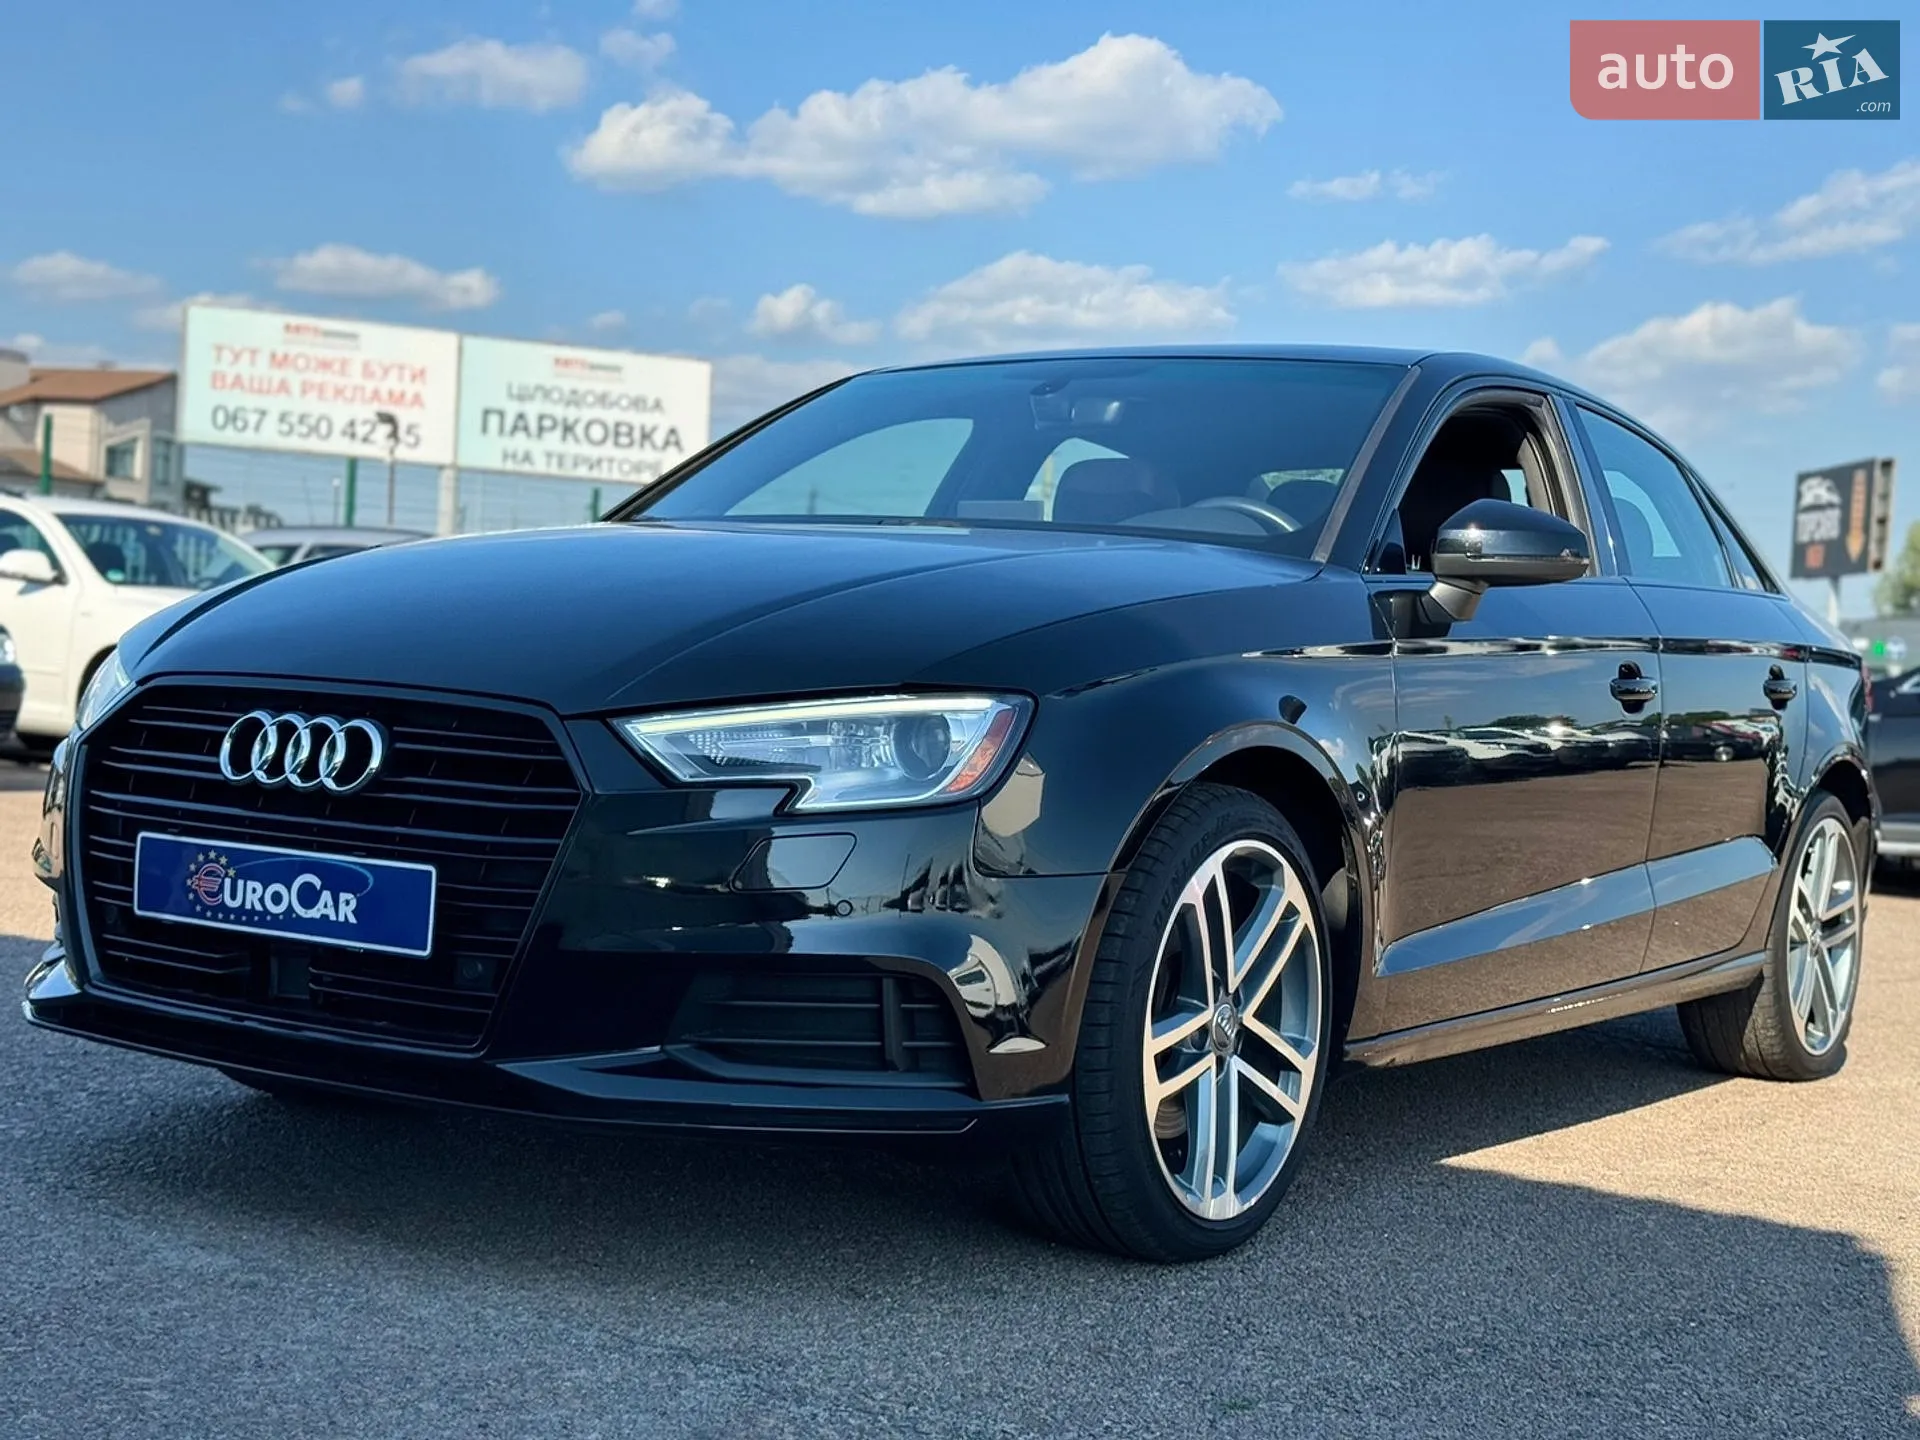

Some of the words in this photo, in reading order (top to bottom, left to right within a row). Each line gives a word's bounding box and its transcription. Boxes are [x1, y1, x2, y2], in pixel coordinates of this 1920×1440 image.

[212, 343, 259, 367] ТУТ
[269, 350, 353, 378] МОЖЕ
[361, 360, 428, 385] БУТИ
[211, 370, 291, 397] ВАША
[300, 379, 424, 409] РЕКЛАМА
[211, 404, 268, 434] 067
[277, 409, 333, 441] 550
[340, 418, 421, 449] 425
[481, 408, 683, 453] ПАРКОВКА
[503, 448, 535, 467] НА
